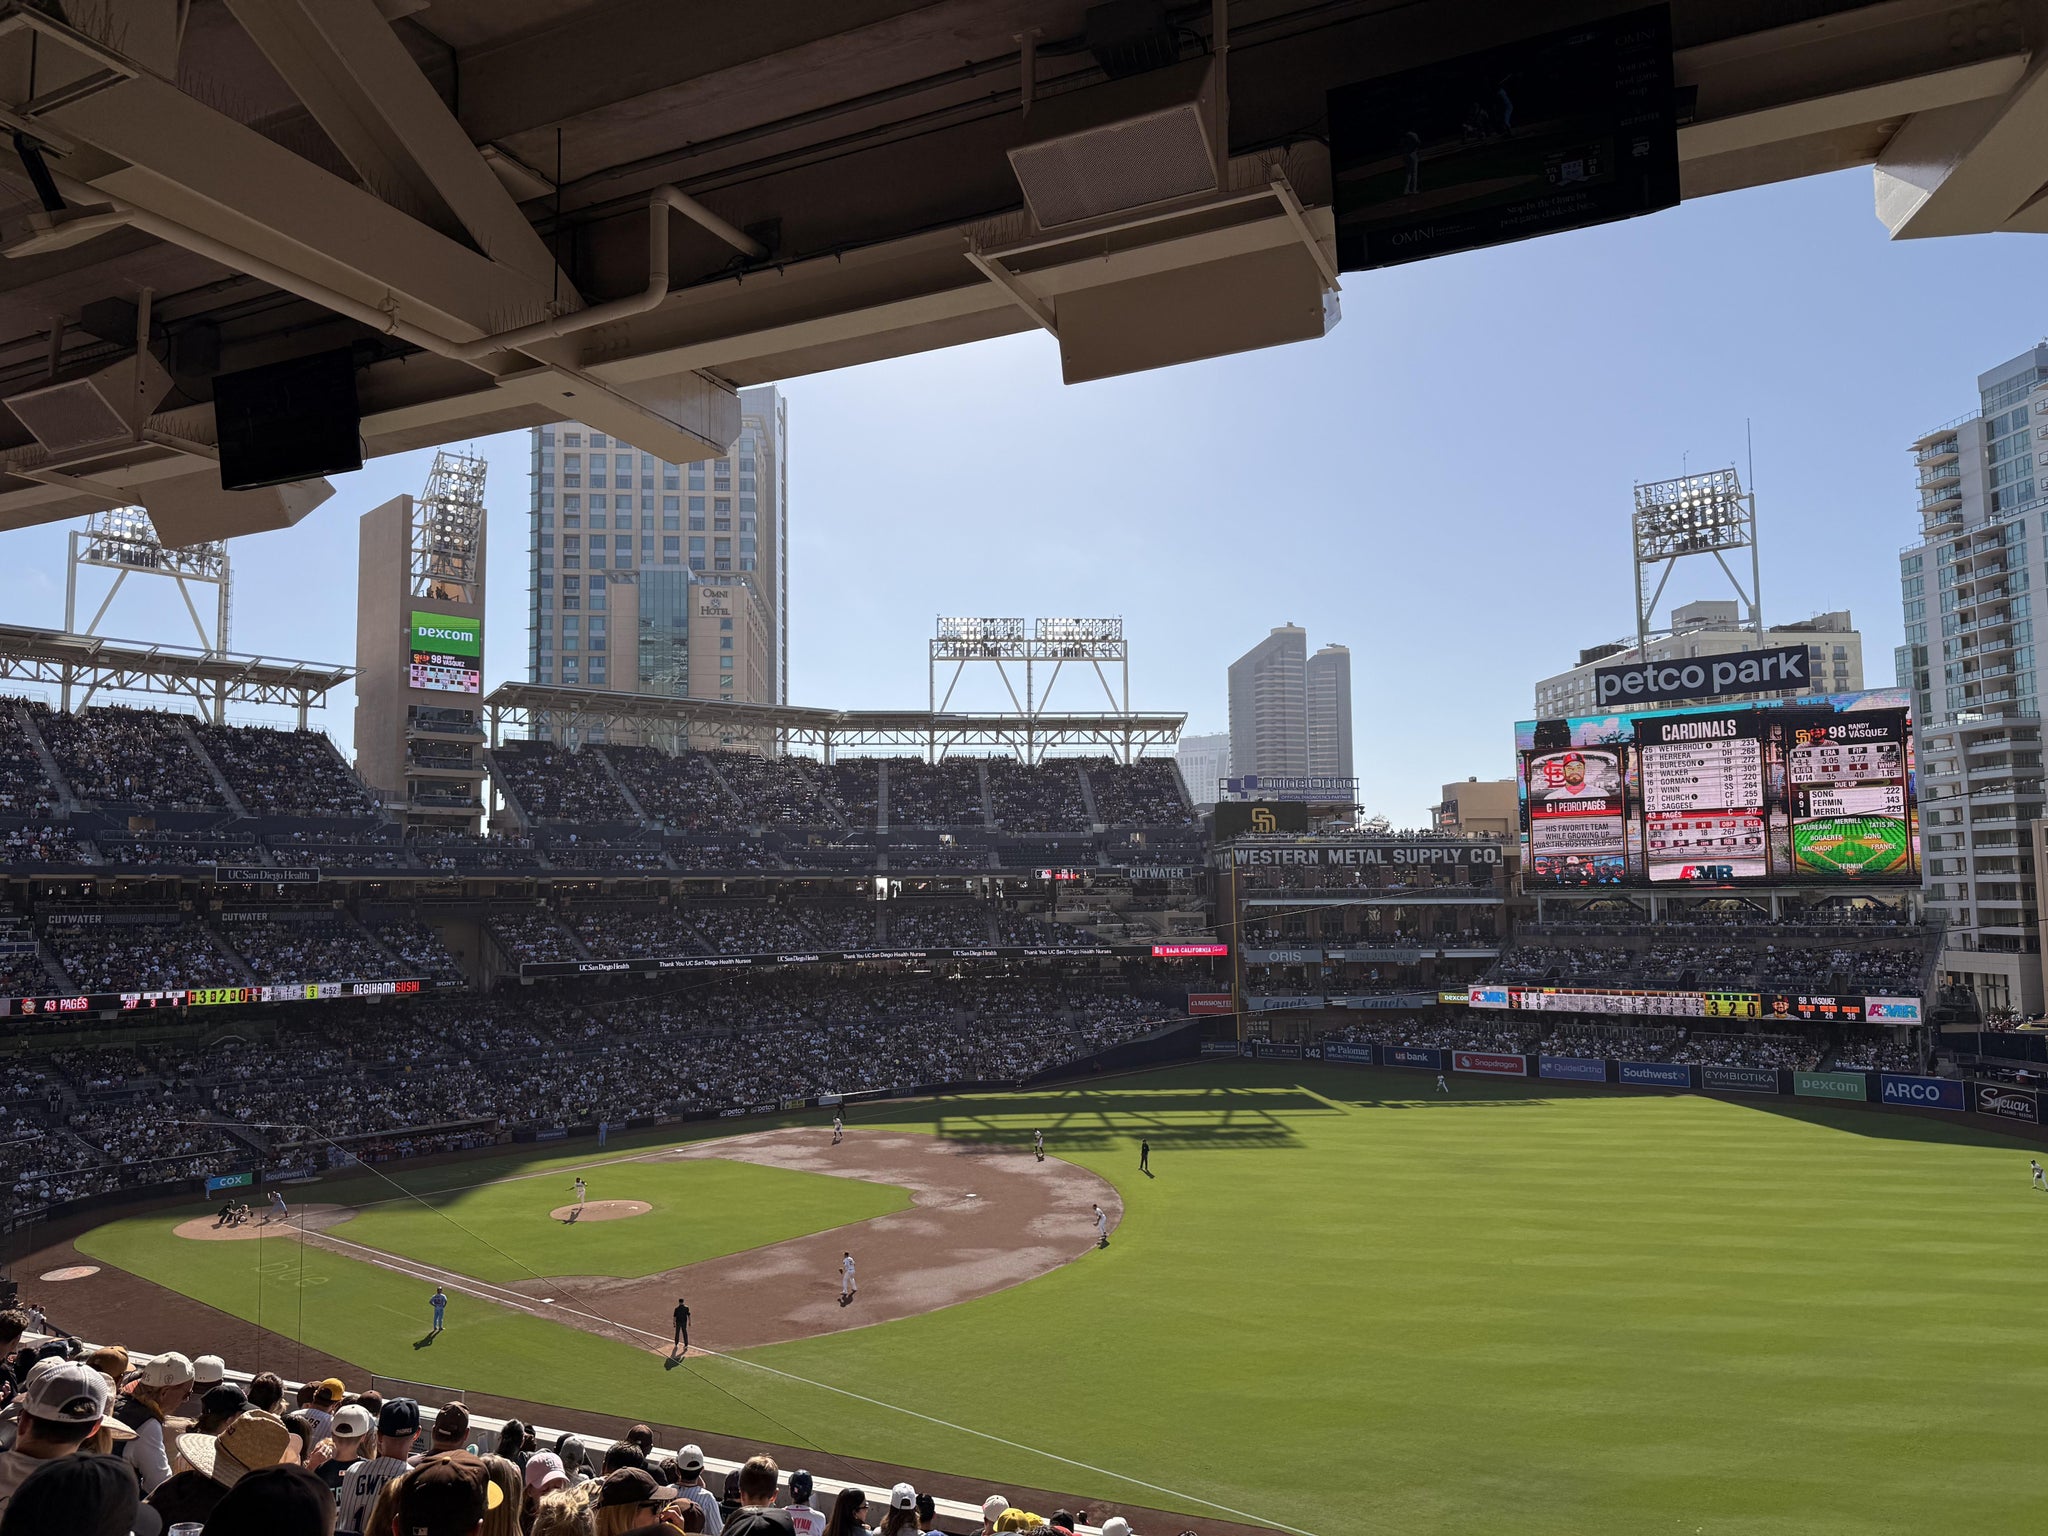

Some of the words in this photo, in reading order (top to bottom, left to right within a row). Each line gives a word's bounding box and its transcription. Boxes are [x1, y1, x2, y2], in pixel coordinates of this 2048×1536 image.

[1392, 226, 1434, 245] OMNI
[703, 588, 728, 598] OMNI
[701, 606, 731, 616] HOTEL
[418, 626, 473, 642] Dexcom
[431, 655, 442, 663] 98
[1600, 664, 1705, 704] petco
[1712, 653, 1804, 694] park
[1662, 720, 1737, 741] CARDINALS
[1829, 726, 1846, 739] 98
[1659, 743, 1704, 753] WETHERHOLT
[1660, 753, 1691, 761] HERRERA
[1660, 760, 1697, 769] BURLESON
[1660, 769, 1688, 777] WALKER
[1262, 778, 1353, 791] QuidelOrtho
[1661, 777, 1691, 785] GORMAN
[1661, 794, 1690, 802] CHURCH
[1813, 799, 1843, 807] FERMIN
[1885, 796, 1900, 804] .143
[1547, 803, 1552, 813] C
[1559, 802, 1582, 812] PEDRO
[1582, 799, 1606, 811] PAGÉS
[1662, 802, 1694, 810] SAGGESE
[1662, 811, 1682, 819] PAGÉS
[1814, 808, 1847, 816] MERRILL
[1234, 850, 1319, 865] WESTERN
[1328, 849, 1388, 865] METAL
[1394, 849, 1462, 864] SUPPLY
[1471, 849, 1500, 864] CO.
[228, 870, 242, 880] UC
[243, 870, 259, 880] San
[260, 870, 283, 881] Diego
[284, 871, 310, 880] Health
[1130, 868, 1184, 878] CUTWATER
[48, 914, 102, 924] CUTWATER
[222, 913, 268, 921] CUTWATER
[1269, 952, 1302, 962] ORIS
[310, 989, 315, 998] 3
[322, 987, 337, 995] 4:52
[396, 981, 420, 992] SUSHI
[200, 991, 206, 1003] 3
[220, 990, 226, 1003] 2
[239, 989, 246, 1001] 0
[1798, 996, 1807, 1004] 98
[44, 1000, 55, 1011] 43
[60, 996, 88, 1010] PAGÉS
[123, 1000, 138, 1008] .217
[150, 999, 156, 1007] 3
[173, 998, 178, 1006] 8
[1361, 996, 1408, 1009] Canel's
[1711, 1002, 1719, 1016] 3
[1729, 1002, 1736, 1016] 2
[1748, 1002, 1755, 1017] 0
[1868, 1004, 1918, 1018] AMR
[1305, 1048, 1321, 1058] 342
[1338, 1046, 1369, 1056] Palomar
[1395, 1052, 1406, 1060] us
[1407, 1052, 1429, 1062] bank
[1475, 1058, 1517, 1070] Snapdragon
[1554, 1062, 1602, 1074] QuidelOrtho
[1624, 1068, 1678, 1081] Southwest
[1705, 1070, 1775, 1083] CYMBIOTIKA
[1802, 1079, 1858, 1093] Dexcom
[1884, 1082, 1940, 1101] ARCO
[1980, 1088, 2032, 1113] Sycuan
[727, 1108, 746, 1116] petco
[758, 1104, 775, 1113] petco
[266, 1171, 303, 1180] Southwest
[220, 1176, 242, 1186] COX
